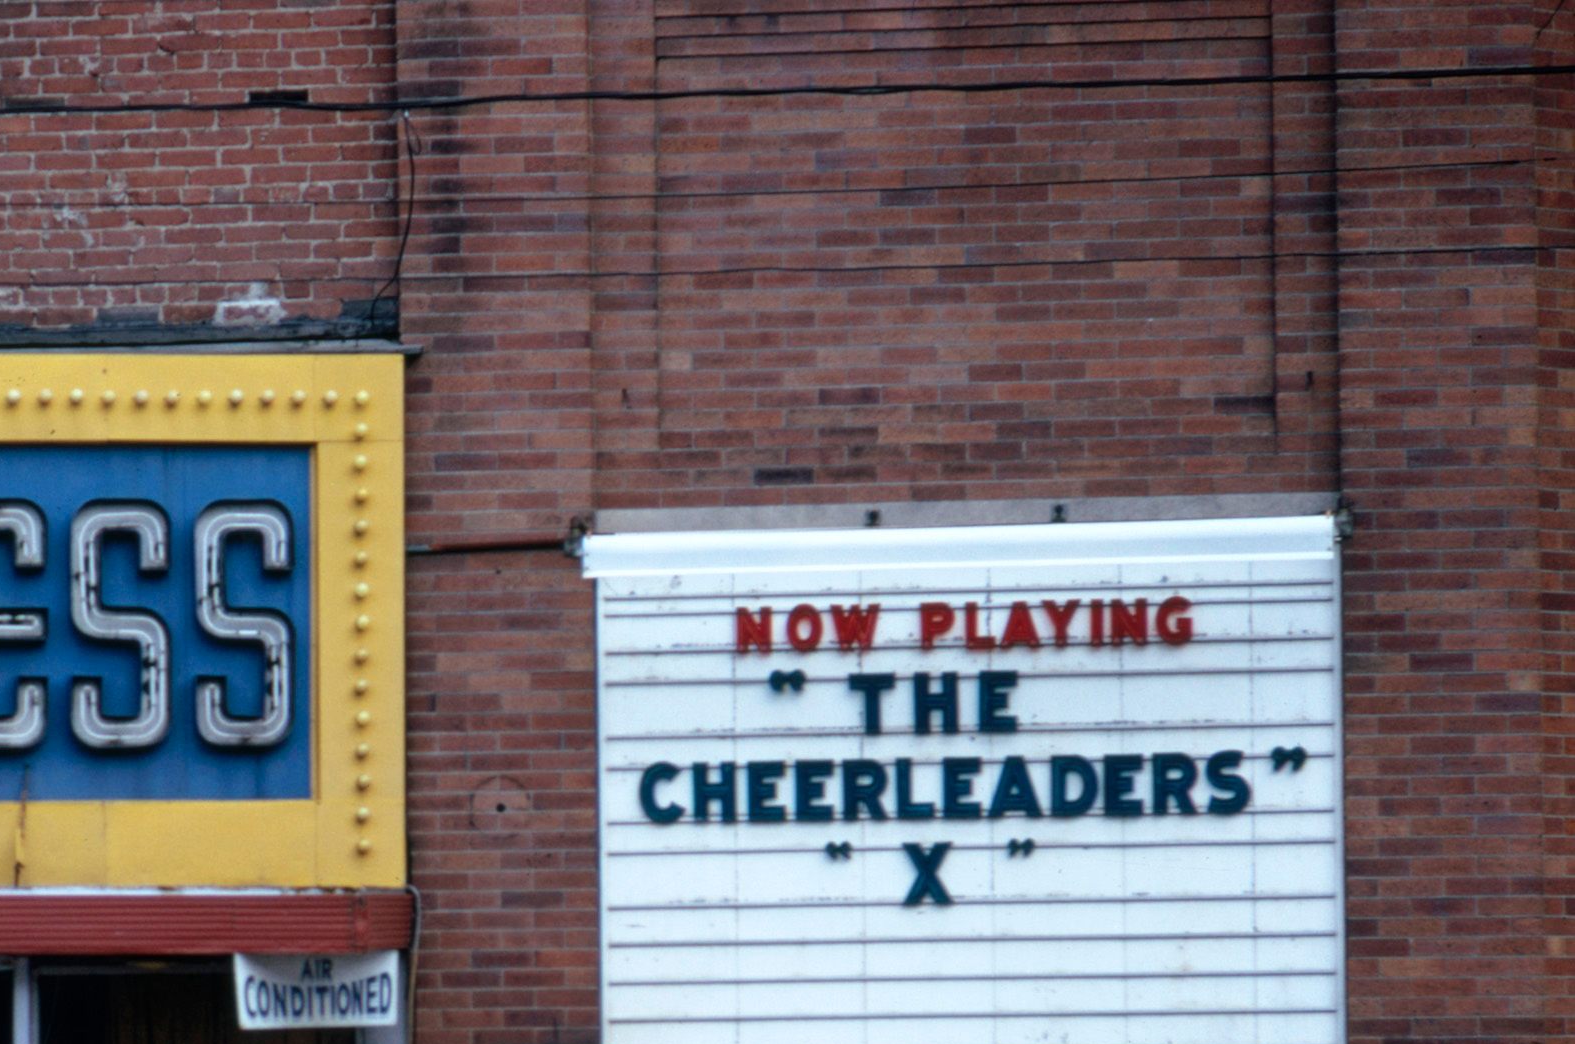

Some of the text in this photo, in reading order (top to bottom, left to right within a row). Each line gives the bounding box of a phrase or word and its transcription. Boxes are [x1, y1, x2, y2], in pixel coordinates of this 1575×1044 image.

[735, 595, 1194, 654] NOW PLAYING
[301, 958, 333, 979] AIR
[245, 972, 392, 1018] CONDITIONED
